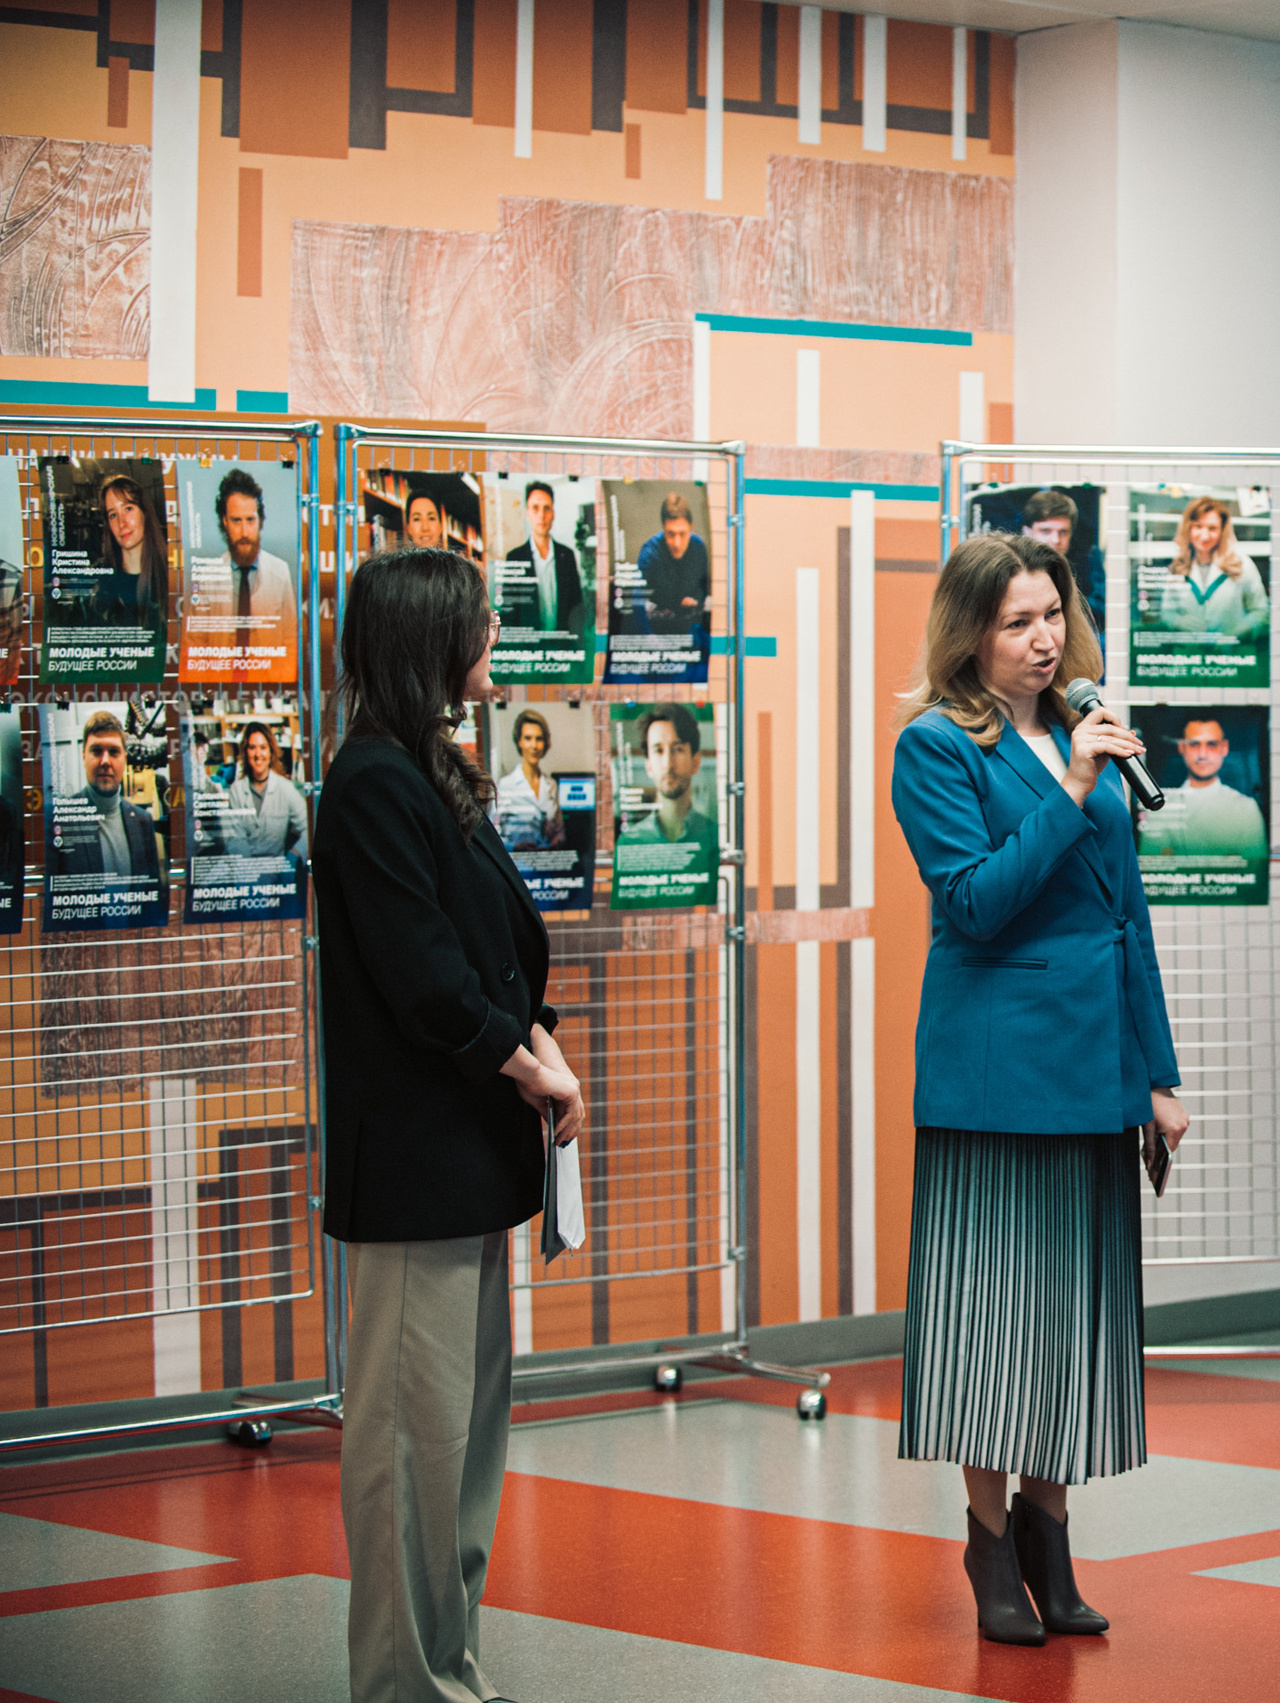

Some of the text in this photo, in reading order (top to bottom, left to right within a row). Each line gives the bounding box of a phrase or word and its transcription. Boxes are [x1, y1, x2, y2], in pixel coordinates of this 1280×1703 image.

[51, 549, 88, 558] Гришина
[51, 558, 90, 567] Кристина
[51, 567, 114, 576] Александровна
[50, 647, 155, 659] МОЛОДЫЕ УЧЕНЫЕ
[188, 646, 286, 658] МОЛОДЫЕ УЧЕНЫЕ
[48, 660, 137, 672] БУДУЩЕЕ РОССИИ
[187, 659, 271, 672] БУДУЩЕЕ РОССИИ
[52, 797, 88, 806] Голышев
[53, 806, 97, 814] Александр
[53, 814, 105, 822] Анатольевич
[193, 884, 297, 898] МОЛОДЫЕ УЧЕНЫЕ
[53, 891, 159, 906] МОЛОДЫЕ УЧЕНЫЕ
[192, 898, 280, 912] БУДУЩЕЕ РОССИИ
[52, 906, 142, 920] БУДУЩЕЕ РОССИИ
